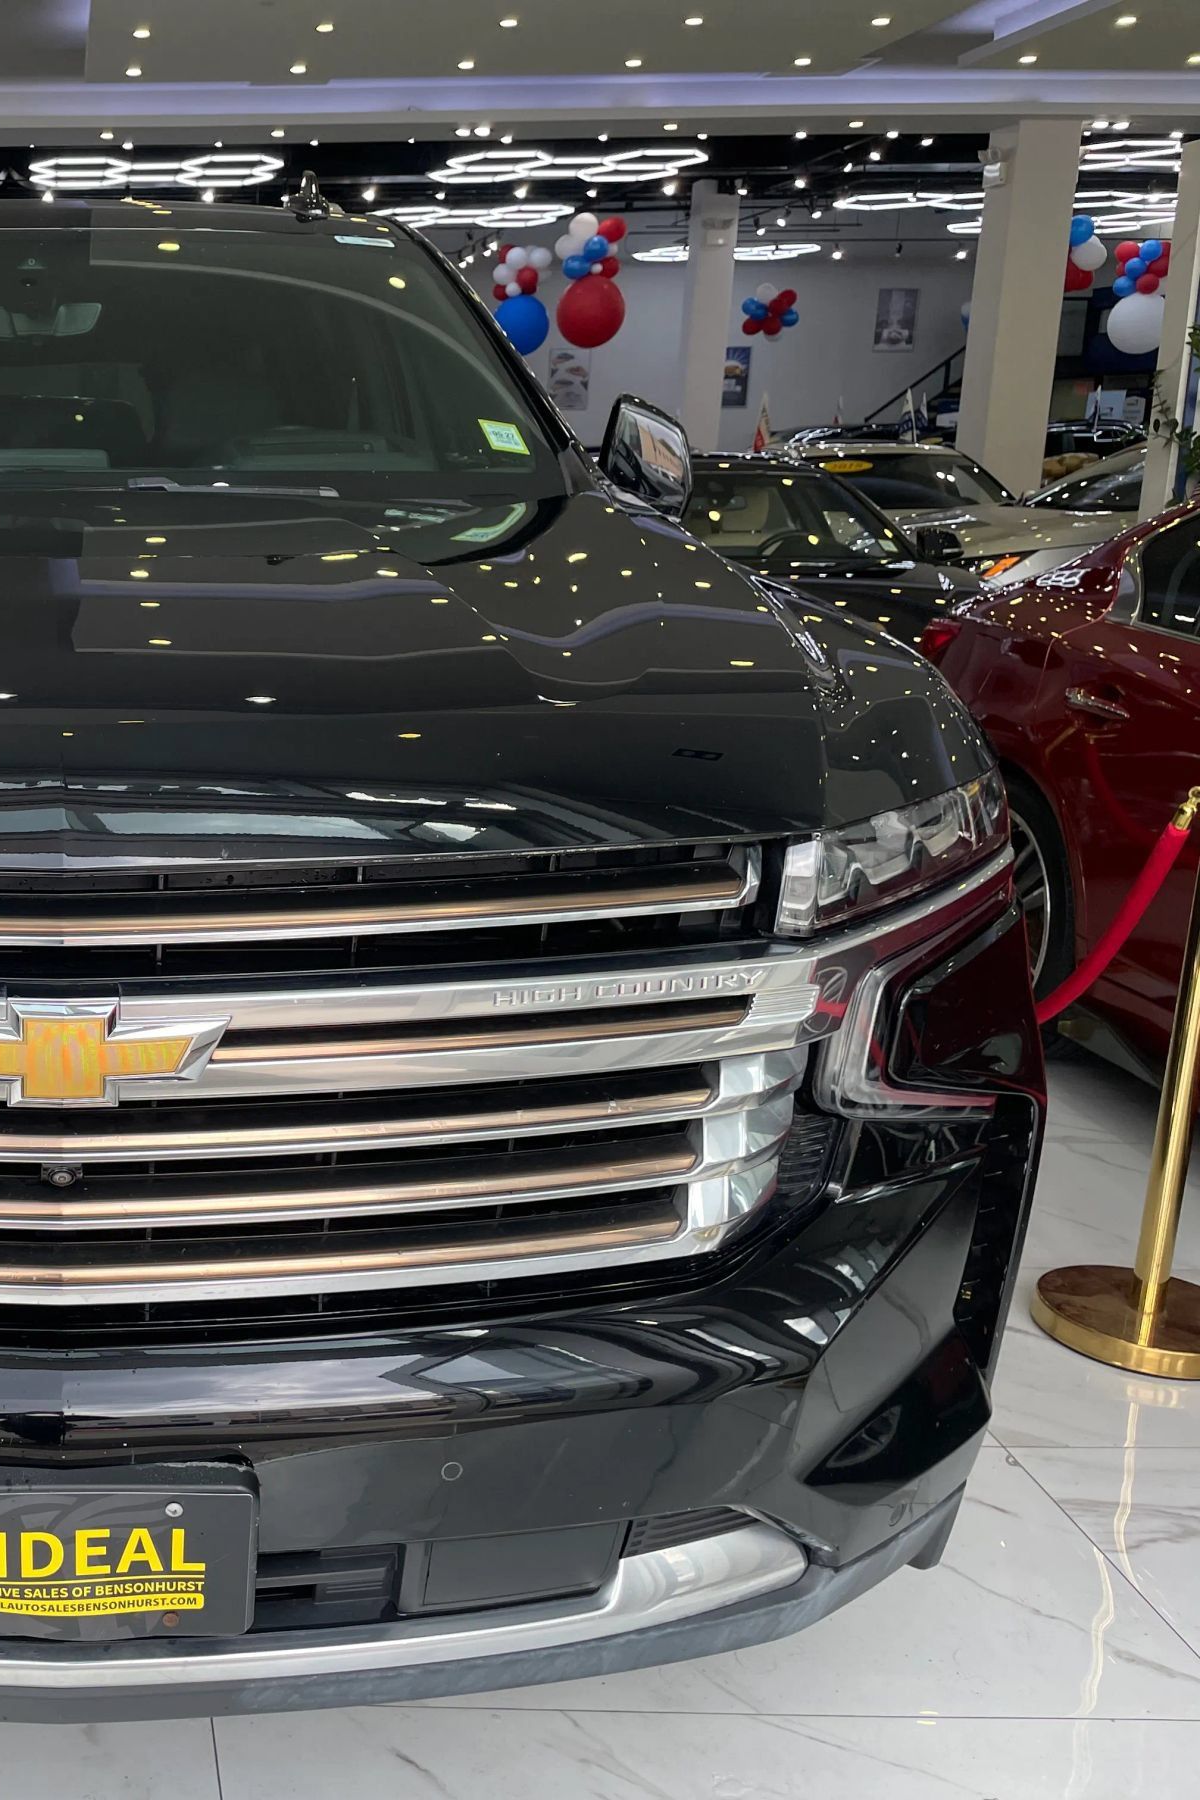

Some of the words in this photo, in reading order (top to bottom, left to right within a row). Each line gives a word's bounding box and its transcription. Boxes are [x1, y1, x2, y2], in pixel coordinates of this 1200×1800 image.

[492, 984, 583, 1008] HIGH
[595, 969, 765, 999] COUNTRY
[24, 1587, 69, 1599] SALES
[72, 1585, 92, 1598] OF
[95, 1581, 205, 1597] BENSONHURST
